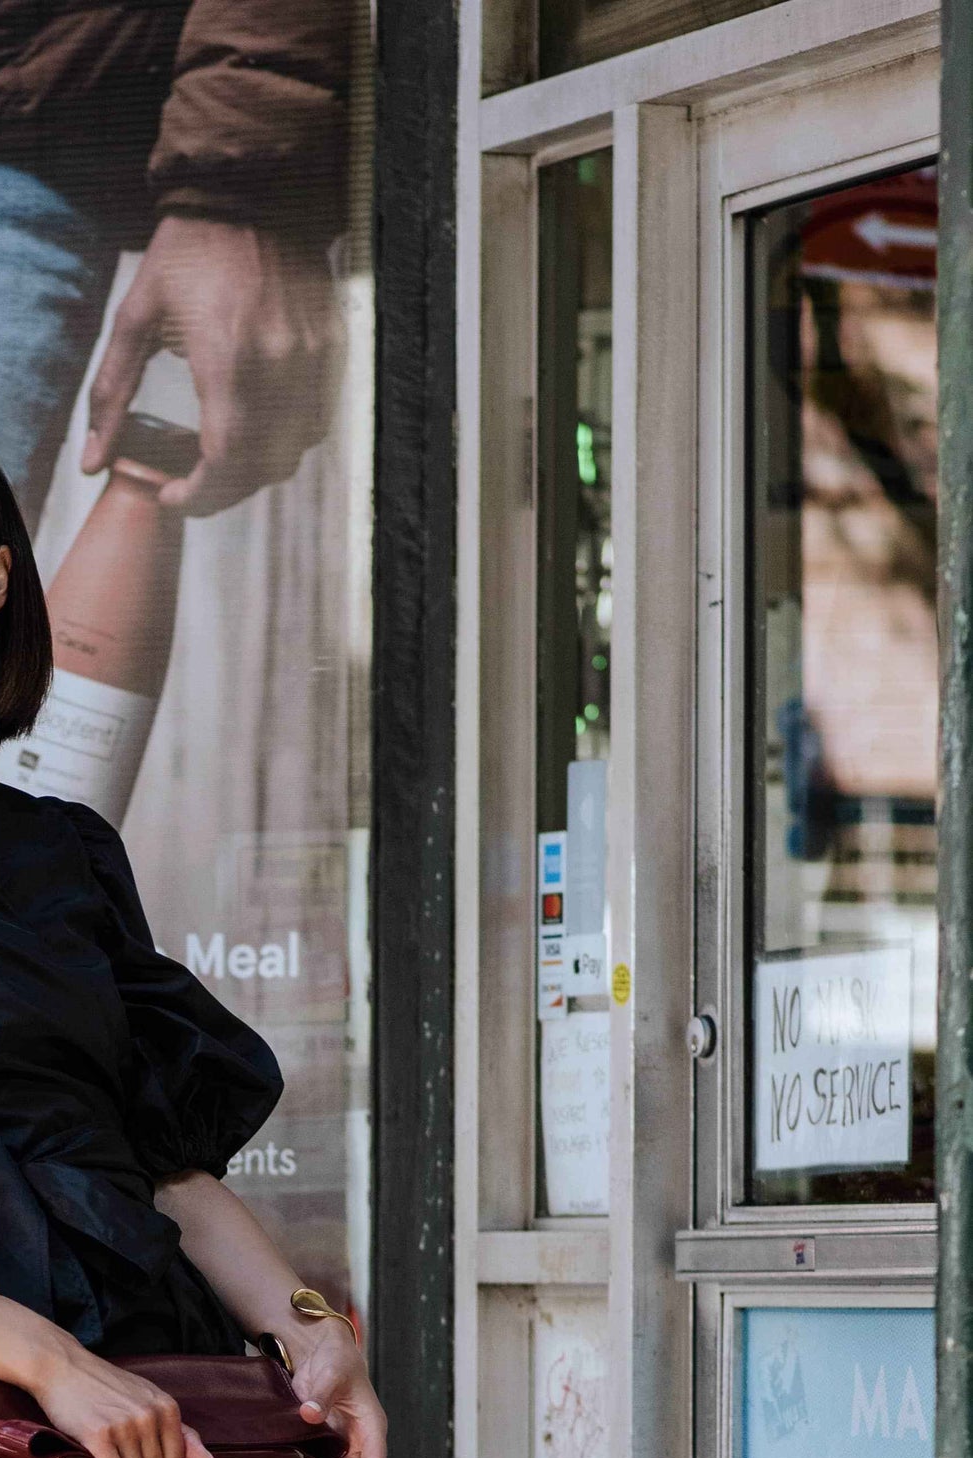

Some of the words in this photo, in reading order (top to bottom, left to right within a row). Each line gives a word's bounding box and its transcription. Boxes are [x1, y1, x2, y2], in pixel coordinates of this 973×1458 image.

[185, 931, 300, 980] Meal
[581, 953, 602, 979] Pay
[772, 985, 802, 1053] NO
[816, 976, 878, 1046] MASK
[770, 1071, 802, 1143] NO
[806, 1059, 902, 1128] SERVICE
